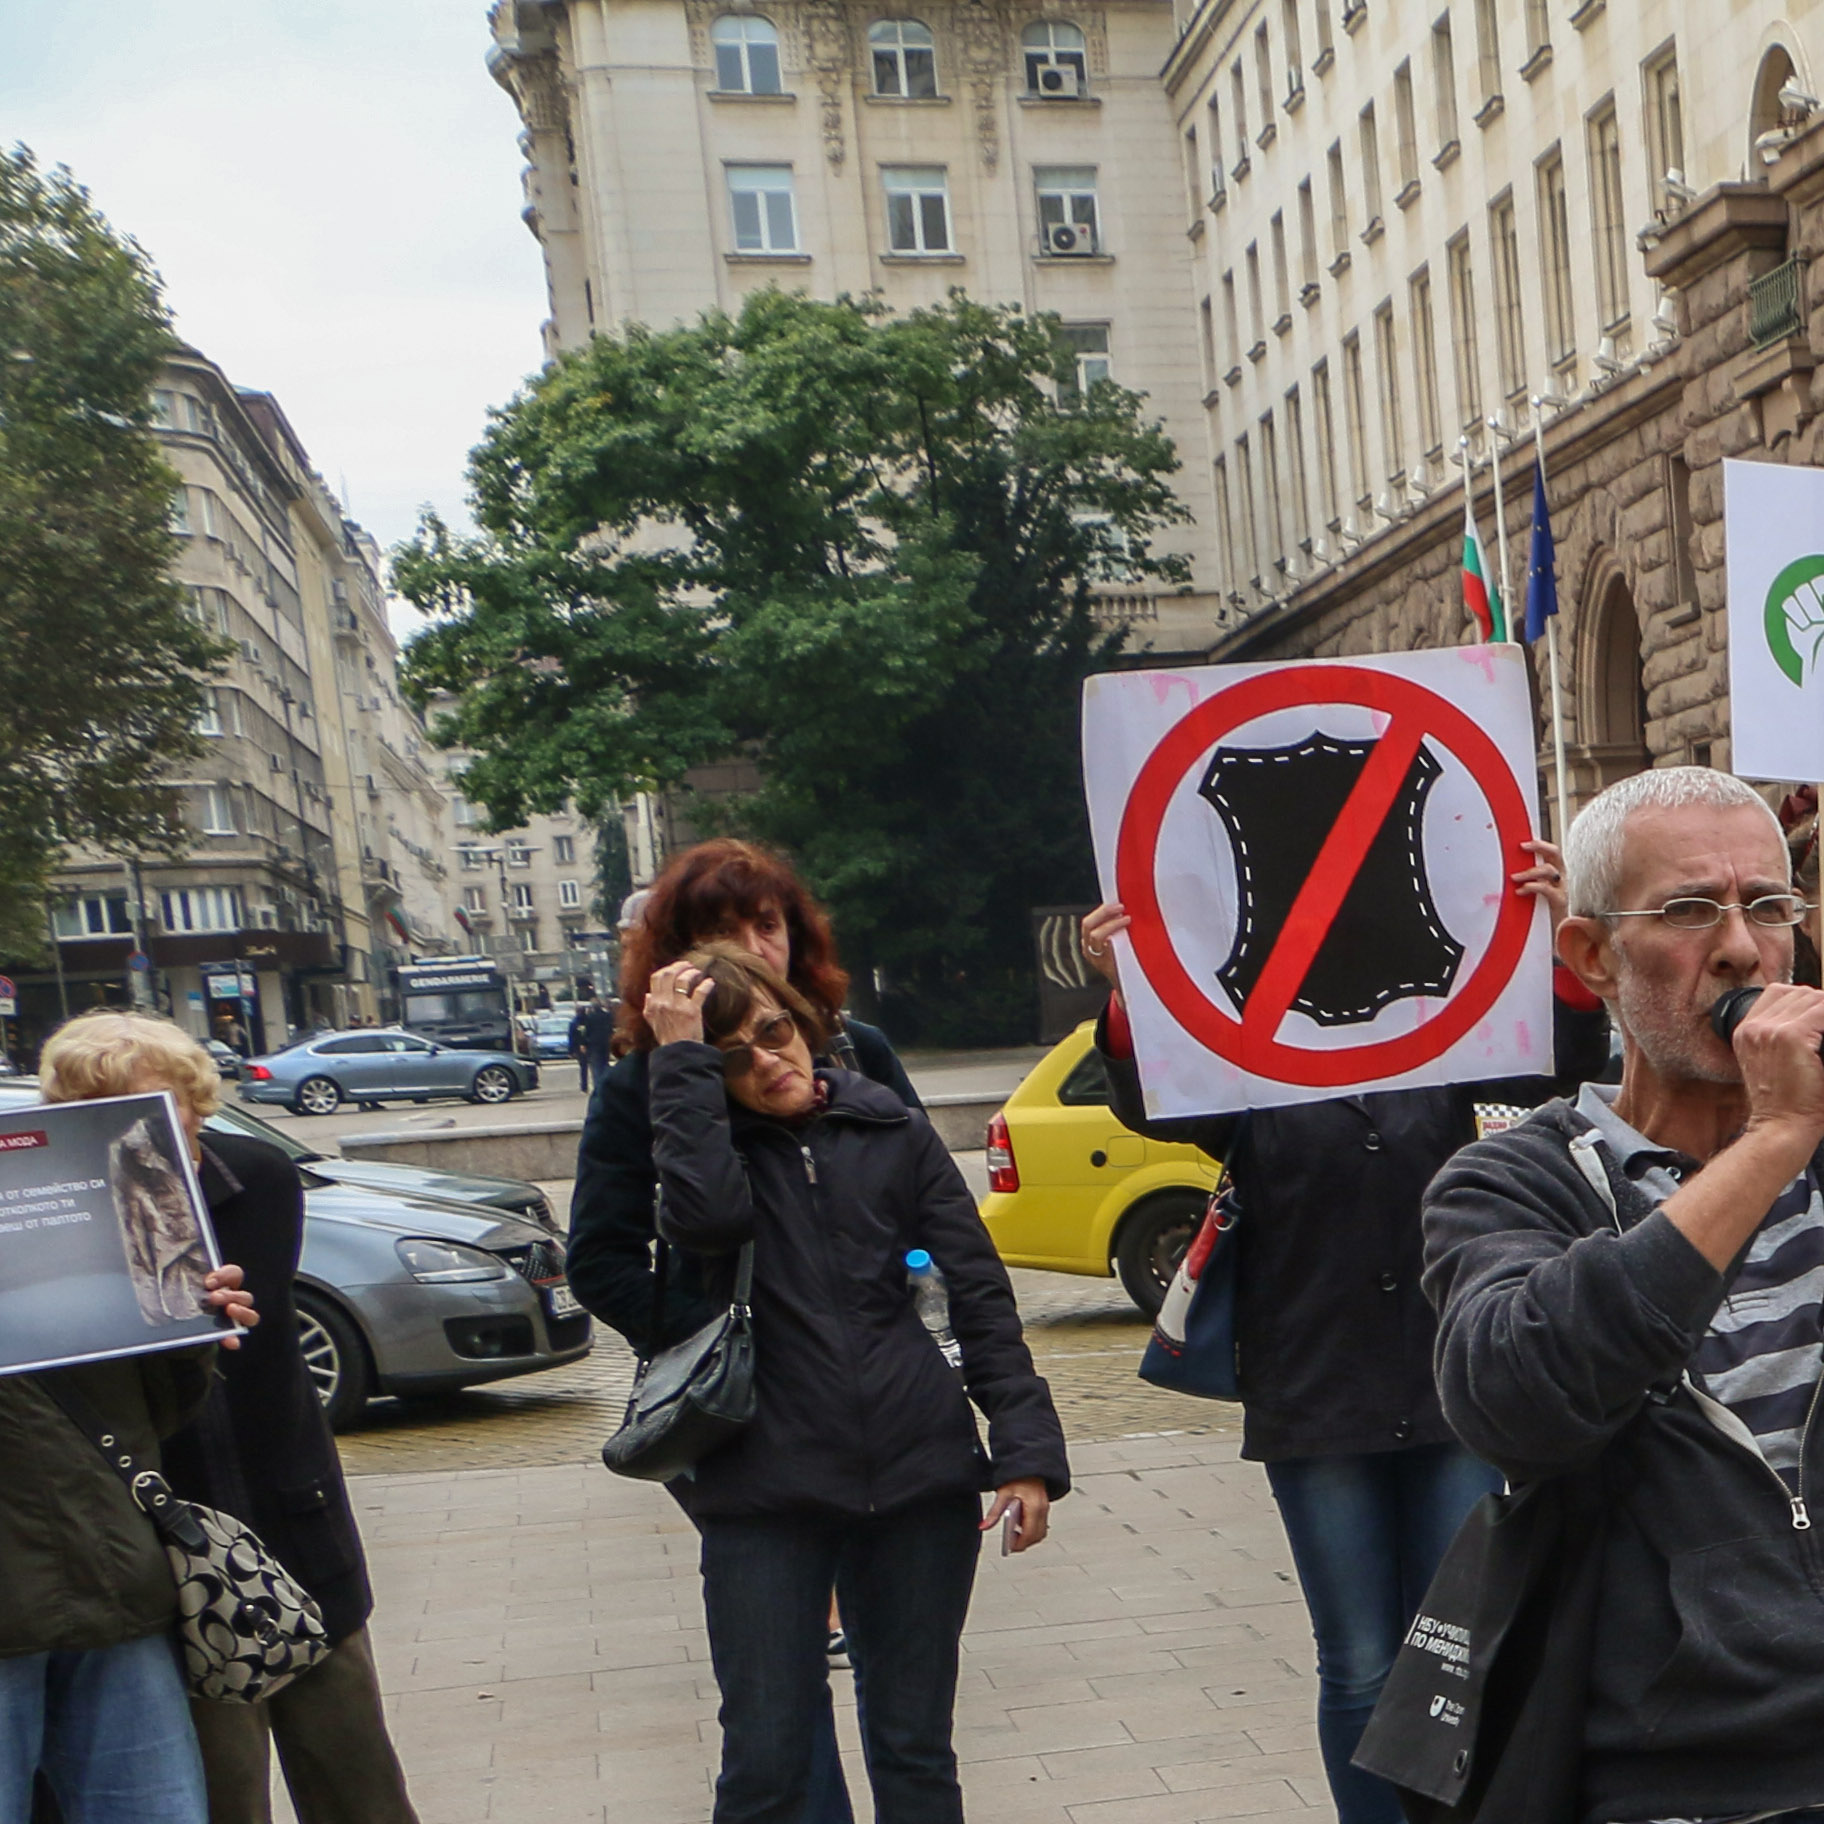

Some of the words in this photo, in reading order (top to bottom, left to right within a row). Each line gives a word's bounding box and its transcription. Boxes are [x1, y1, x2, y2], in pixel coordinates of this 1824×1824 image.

[409, 974, 490, 988] GENDARMERIE
[6, 1191, 20, 1201] от
[22, 1180, 88, 1199] семейство
[89, 1178, 106, 1190] си
[61, 1199, 76, 1209] ти
[25, 1219, 39, 1229] от
[42, 1212, 92, 1227] палтото
[1410, 1631, 1428, 1648] ПО
